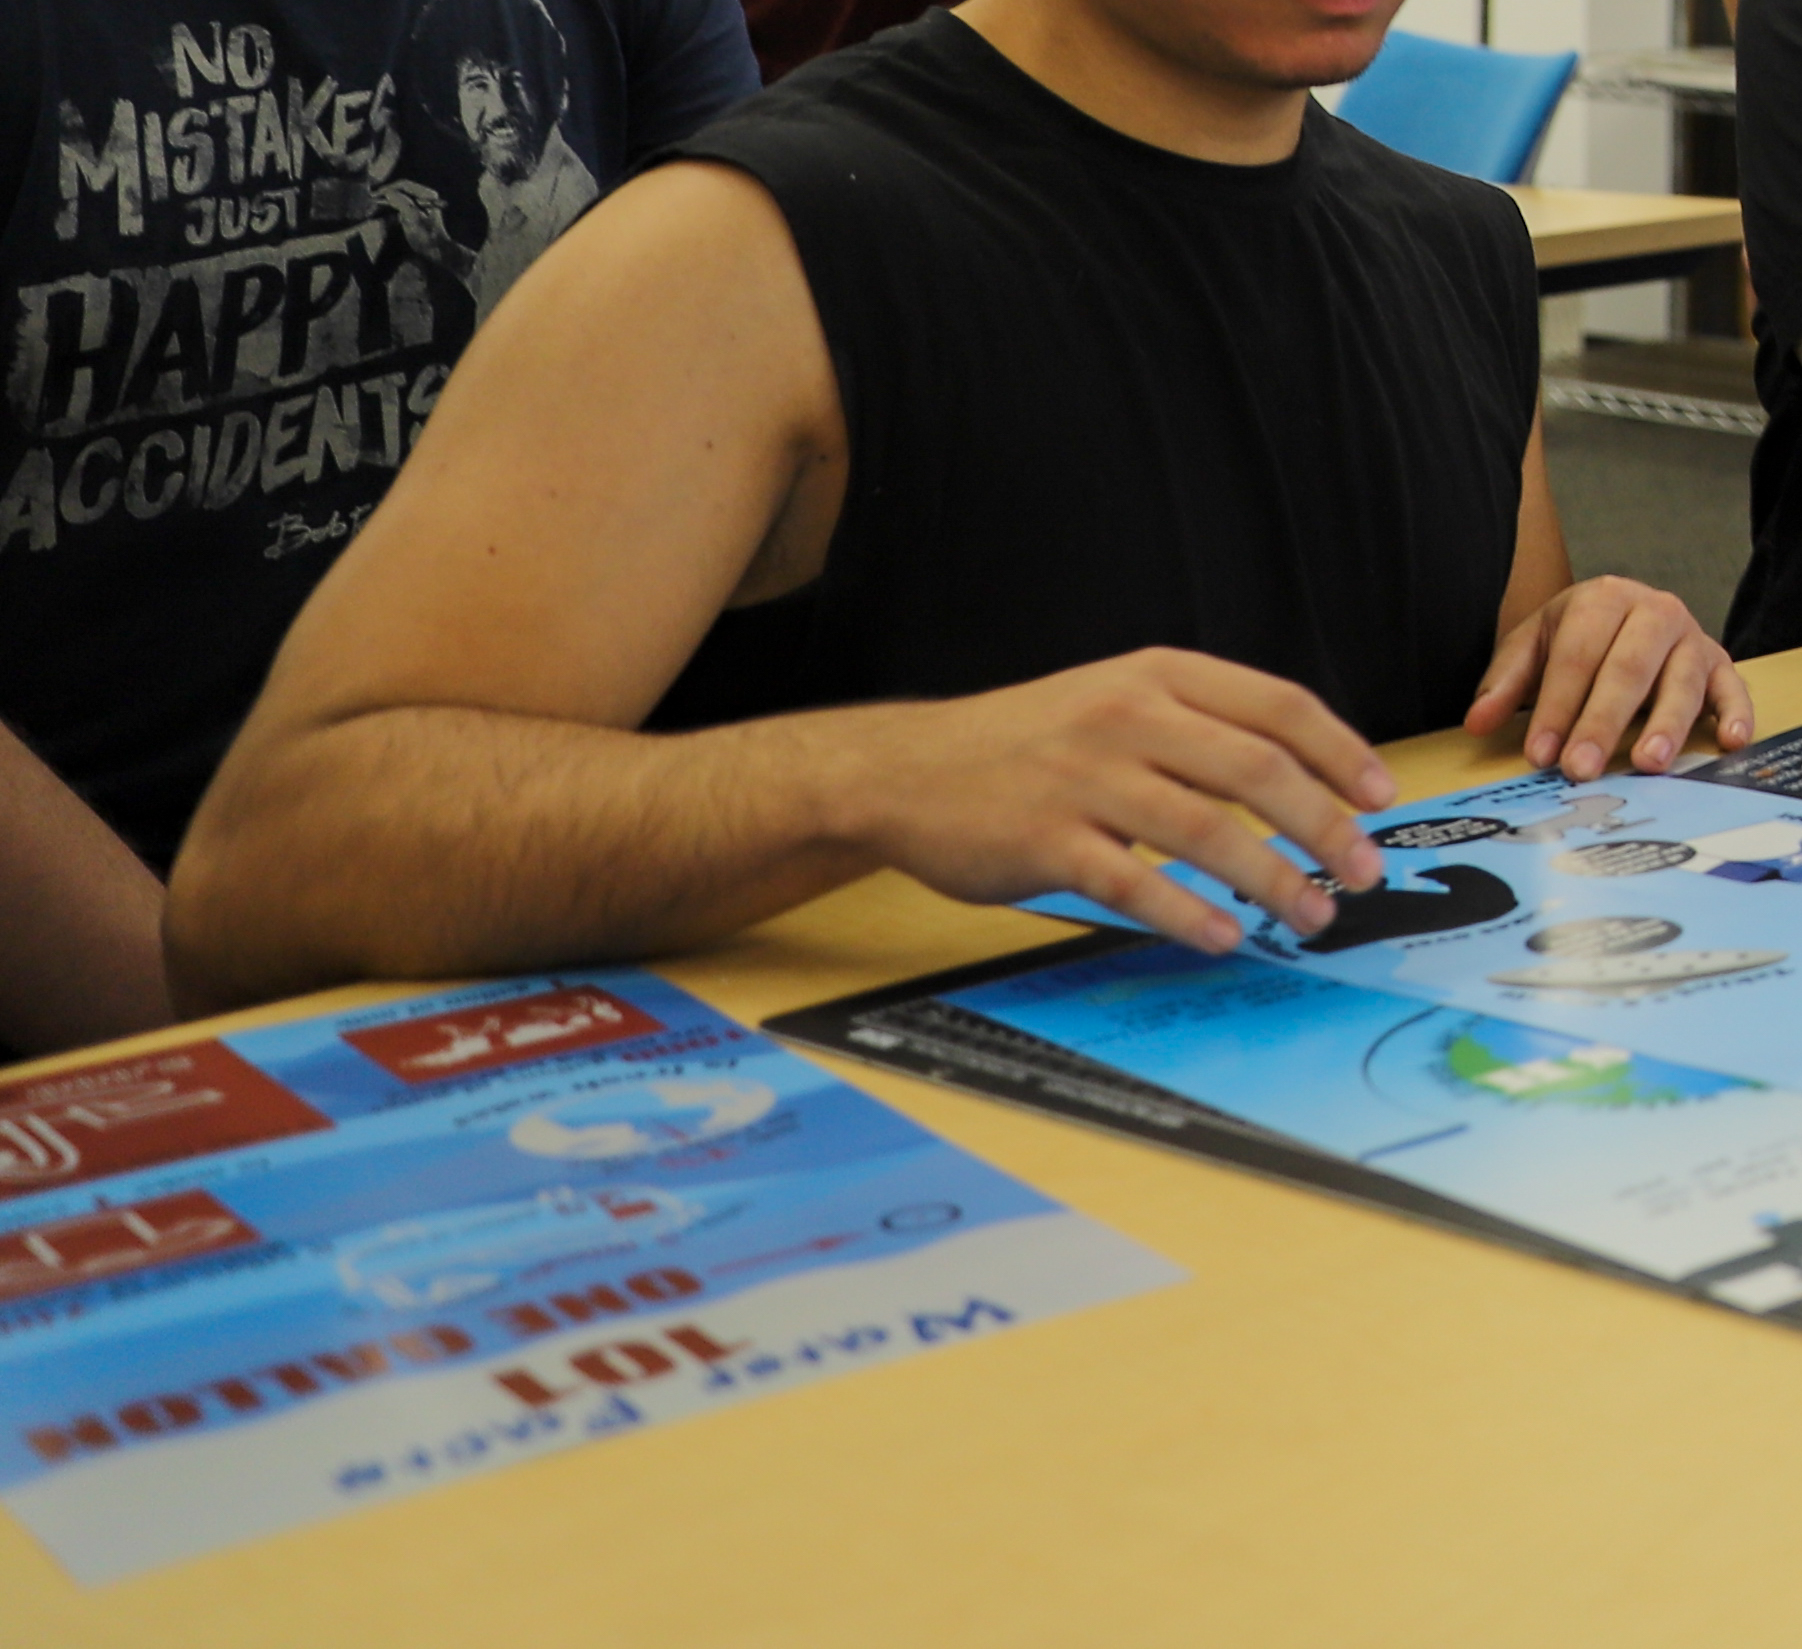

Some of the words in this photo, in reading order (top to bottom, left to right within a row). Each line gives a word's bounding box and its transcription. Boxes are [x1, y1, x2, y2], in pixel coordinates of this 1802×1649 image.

[171, 20, 276, 98] NO
[54, 72, 402, 240] MISTAKES
[183, 186, 301, 247] JUST
[25, 226, 410, 435] HAPPY
[0, 362, 452, 552] ACCIDENTS
[482, 1264, 706, 1342] ONE
[703, 1293, 1018, 1396] Water
[22, 1320, 474, 1466] GALLON
[490, 1320, 752, 1410] 101
[335, 1392, 648, 1500] Facts
